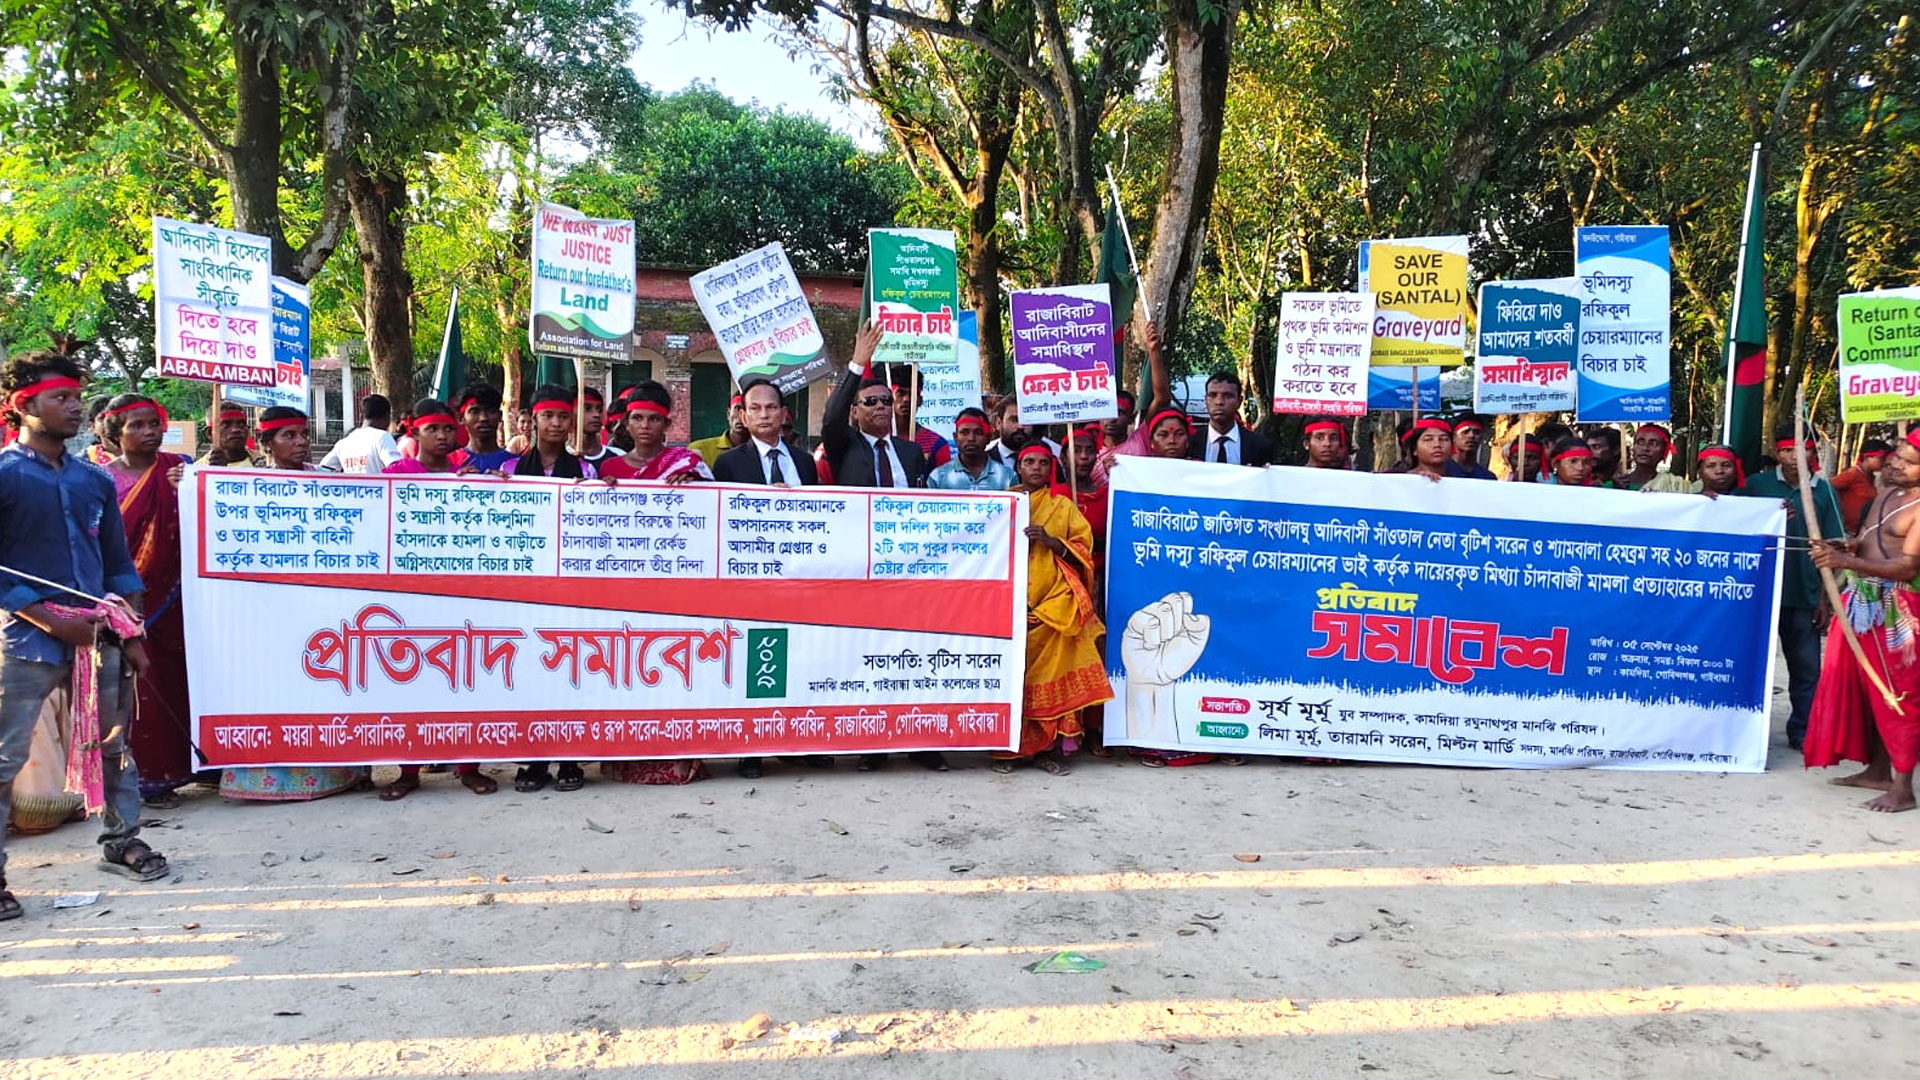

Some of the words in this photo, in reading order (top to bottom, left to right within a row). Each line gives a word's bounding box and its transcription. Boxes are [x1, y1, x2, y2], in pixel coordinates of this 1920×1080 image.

[543, 211, 561, 232] WE
[563, 219, 598, 237] WANT
[604, 225, 631, 244] JUST
[160, 226, 220, 255] আদিবাসী
[225, 236, 269, 262] হিসেবে
[562, 239, 611, 264] JUSTICE
[180, 258, 253, 284] সাংবিধানিক
[1394, 254, 1442, 269] SAVE
[538, 259, 567, 279] Return
[570, 269, 583, 284] our
[586, 268, 631, 292] forefather's
[1398, 273, 1438, 287] OUR
[1582, 271, 1633, 293] ভূমিদস্যু
[561, 287, 609, 311] Land
[1293, 300, 1325, 313] সমতল
[1329, 297, 1362, 316] ভূমিতে
[1376, 289, 1461, 308] (SANTAL)
[177, 304, 220, 329] দিতে
[226, 316, 258, 336] হবে
[926, 304, 953, 337] চাই
[1025, 303, 1096, 322] রাজাবিরাট
[1497, 299, 1536, 323] ফিরিয়ে
[1540, 302, 1562, 321] দাও
[1851, 307, 1908, 324] Return
[1017, 321, 1106, 341] আদিবাসীদের
[1283, 320, 1307, 338] পৃথক
[1311, 318, 1329, 338] ভূমি
[1333, 320, 1369, 336] কমিশন
[1373, 314, 1461, 342] Graveyard
[1483, 330, 1531, 350] আমাদের
[1535, 322, 1574, 347] শতবর্ষী
[1582, 330, 1663, 345] চেয়ারম্যানের
[180, 331, 219, 355] দিয়ে
[225, 341, 256, 360] দাও
[540, 331, 588, 346] Association
[591, 337, 602, 347] for
[604, 339, 623, 350] Land
[1030, 341, 1096, 359] সমাধিস্থল
[1297, 338, 1316, 358] ভূমি
[163, 358, 273, 384] ABALAMBAN
[277, 357, 302, 387] চাই
[1292, 358, 1321, 377] গঠন
[1328, 366, 1350, 378] কর
[1482, 358, 1569, 387] সমাধিস্থান
[1581, 353, 1618, 373] বিচার
[1622, 354, 1647, 373] চাই
[1022, 371, 1071, 396] ফেরত
[1076, 361, 1110, 391] চাই
[1283, 380, 1325, 394] করতে
[1330, 382, 1357, 395] হবে
[216, 481, 247, 496] রাজা
[254, 478, 298, 496] বিরাটে
[304, 481, 383, 499] সাঁওতালদের
[396, 483, 420, 505] ভূমি
[215, 502, 249, 519] উপর
[563, 488, 585, 504] ওসি
[652, 489, 685, 512] কর্তৃক
[775, 500, 846, 514] চেয়ারম্যানকে
[411, 506, 446, 525] সন্ত্রাসী
[450, 507, 483, 531] কর্তৃক
[562, 509, 630, 528] সাঁওতালদের
[634, 511, 673, 529] বিরুদ্ধে
[678, 512, 706, 529] মিথ্যা
[873, 520, 898, 535] জাল
[900, 518, 930, 535] দলিল
[964, 523, 986, 535] করে
[233, 529, 259, 543] তার
[266, 526, 306, 544] সন্ত্রাসী
[312, 526, 354, 545] বাহিনী
[395, 529, 448, 548] হাঁসদাকে
[452, 535, 486, 549] হামলা
[505, 531, 547, 551] বাড়ীতে
[562, 531, 612, 550] চাঁদাবাজী
[616, 536, 650, 550] মামলা
[728, 537, 775, 555] আসামীর
[1131, 506, 1199, 532] রাজাবিরাটে
[1202, 510, 1255, 536] জাতিগত
[1258, 518, 1311, 545] সংখ্যালঘু
[1313, 518, 1370, 545] আদিবাসী
[1373, 521, 1424, 548] সাঁওতাল
[1427, 532, 1457, 552] নেতা
[1460, 528, 1491, 559] বৃটিশ
[1495, 535, 1529, 557] সরেন
[1547, 538, 1603, 562] শ্যামবালা
[1651, 546, 1671, 567] সহ
[1674, 548, 1691, 568] ২০
[1696, 549, 1732, 569] জনের
[1733, 552, 1762, 571] নামে
[874, 539, 894, 554] ২টি
[898, 543, 919, 556] খাস
[215, 548, 254, 572] কর্তৃক
[259, 554, 309, 568] হামলার
[315, 550, 350, 568] বিচার
[356, 552, 380, 569] চাই
[395, 552, 474, 572] অগ্নিসংযোগের
[478, 553, 509, 571] বিচার
[513, 555, 534, 572] চাই
[561, 558, 592, 571] করার
[595, 554, 646, 573] প্রতিবাদে
[649, 555, 673, 574] তীব্র
[677, 556, 704, 573] নিন্দা
[728, 559, 758, 576] বিচার
[763, 559, 783, 576] চাই
[906, 559, 949, 576] প্রতিবাদ
[1132, 537, 1161, 567] ভূমি
[1165, 544, 1194, 568] দস্যু
[1198, 541, 1249, 573] রফিকুল
[1252, 551, 1338, 574] চেয়ারম্যানের
[1342, 552, 1370, 578] ভাই
[1373, 554, 1411, 586] কর্তৃক
[1414, 562, 1480, 591] দায়েরকৃত
[1484, 561, 1521, 588] মিথ্যা
[1522, 563, 1584, 591] চাঁদাবাজী
[1587, 571, 1629, 594] মামলা
[1632, 576, 1705, 599] প্রত্যাহারের
[1708, 576, 1756, 601] দাবীতে
[1316, 582, 1418, 614] প্রতিবাদ
[302, 603, 528, 696] প্রতিবাদ
[534, 621, 744, 690] সমাবেশ
[1307, 611, 1569, 684] সমাবেশ
[1674, 644, 1699, 653] ২০২৫
[927, 649, 961, 675] বৃটিস
[966, 653, 1002, 670] সরেন
[913, 676, 938, 690] আইন
[942, 678, 981, 690] কলেজের
[1258, 696, 1293, 721] সূর্য
[1414, 713, 1460, 727] কামদিয়া
[1464, 717, 1517, 732] রঘুনাথপুর
[416, 721, 473, 746] শ্যামবালা
[604, 720, 624, 743] রূপ
[1258, 725, 1290, 742] লিমা
[1328, 730, 1384, 746] তারামনি
